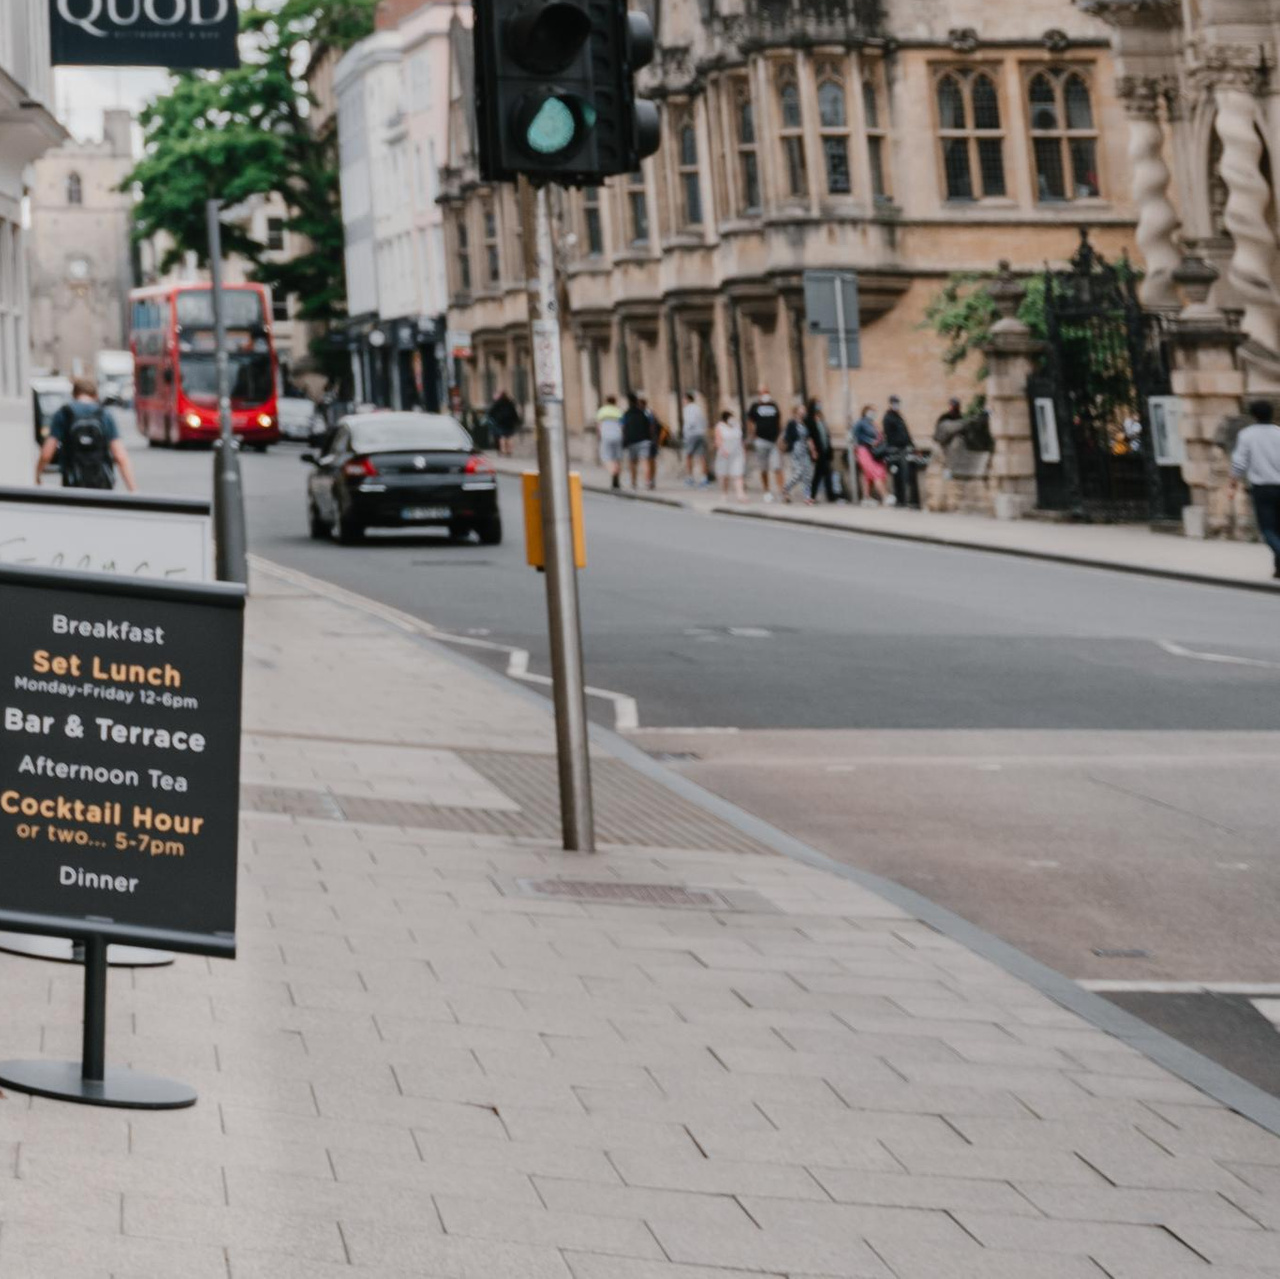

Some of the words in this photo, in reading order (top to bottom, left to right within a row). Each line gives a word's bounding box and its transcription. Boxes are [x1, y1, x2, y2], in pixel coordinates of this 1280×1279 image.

[52, 613, 166, 646] Breakfast
[33, 648, 82, 677] Set
[92, 655, 182, 688] Lunch
[14, 675, 135, 705] Monday-Friday
[140, 689, 199, 710] 12-6pm
[4, 706, 55, 735] Bar
[63, 713, 85, 739] &
[95, 716, 207, 753] Terrace
[18, 754, 139, 787] Afternoon
[147, 768, 189, 793] Tea
[0, 790, 121, 826] Cocktail
[133, 805, 205, 835] Hour
[16, 823, 40, 839] or
[48, 824, 108, 848] two...
[114, 831, 185, 857] 5-7pm
[59, 865, 140, 894] Dinner
